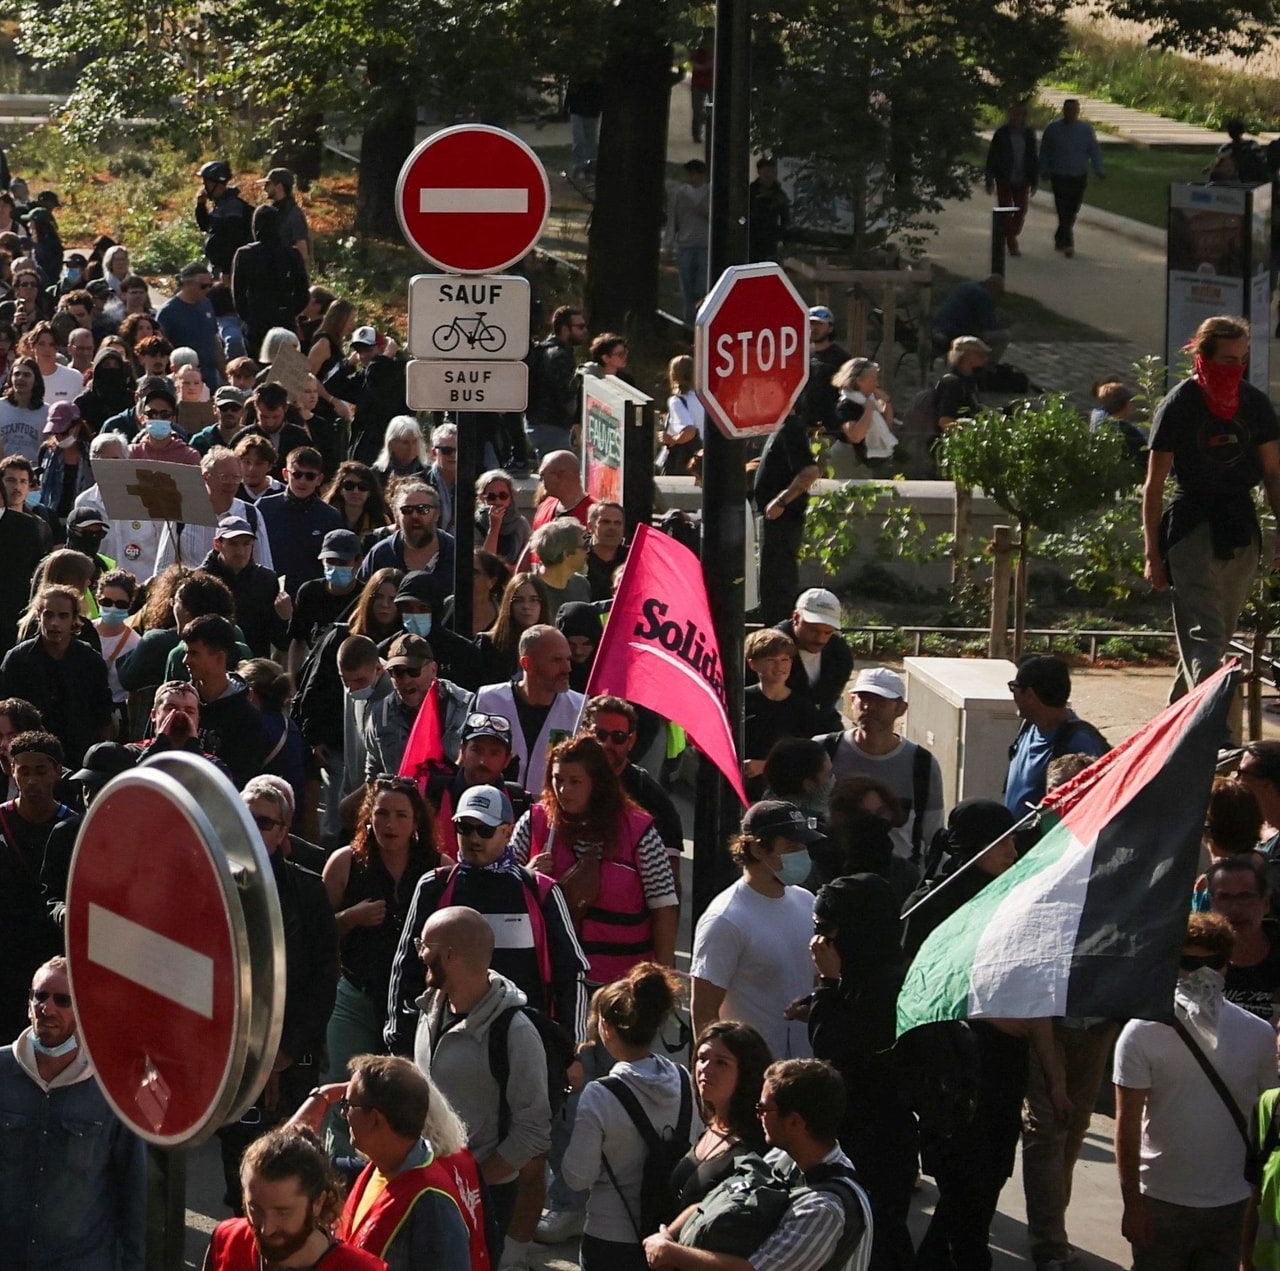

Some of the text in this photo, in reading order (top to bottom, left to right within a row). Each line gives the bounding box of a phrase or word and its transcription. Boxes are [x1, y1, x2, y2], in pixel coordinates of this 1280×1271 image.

[439, 284, 503, 305] SAUF
[715, 324, 799, 380] STOP
[444, 370, 493, 384] SAUF
[450, 388, 486, 403] BUS
[588, 413, 622, 463] FAUVES
[633, 596, 728, 710] Solida
